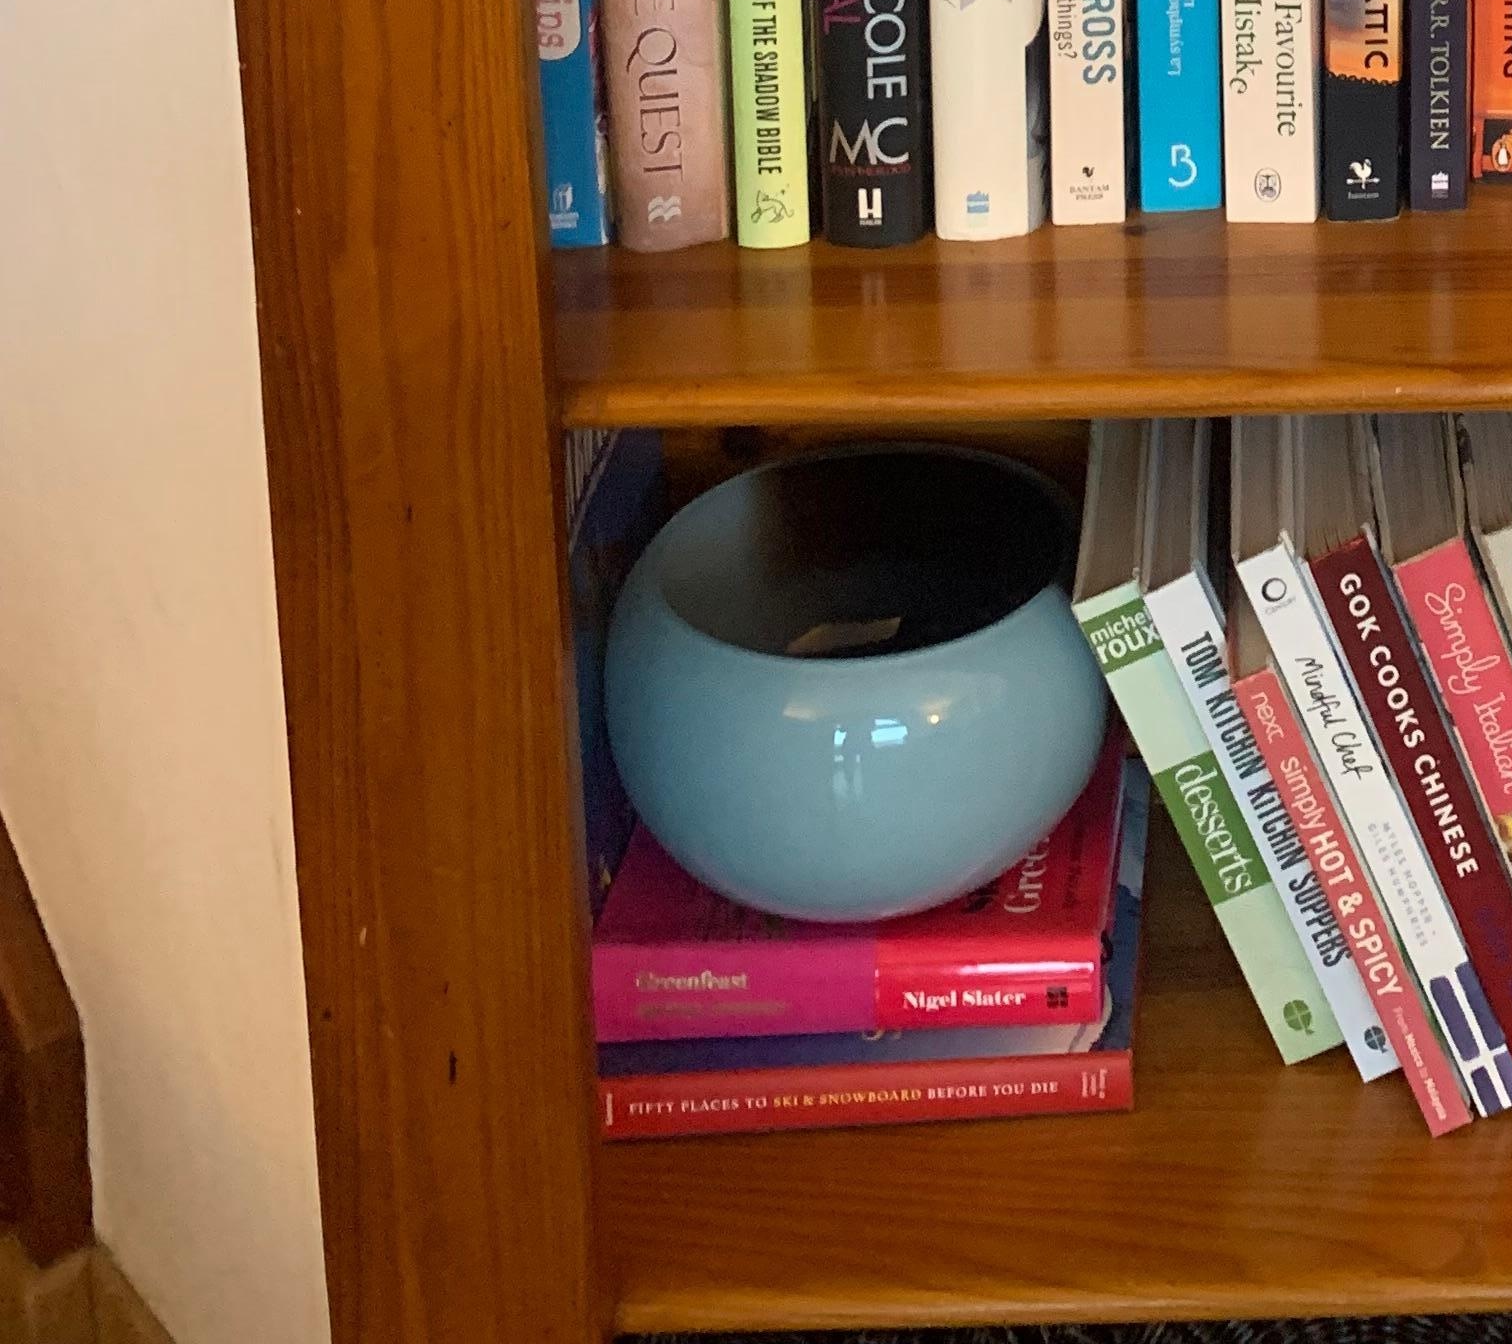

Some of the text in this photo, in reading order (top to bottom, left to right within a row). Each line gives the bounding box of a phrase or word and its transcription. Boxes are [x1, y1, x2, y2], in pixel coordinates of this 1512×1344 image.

[752, 15, 777, 47] THE
[753, 50, 780, 121] SHADOW
[756, 127, 782, 175] BIBLE
[1340, 572, 1479, 878] GOK COOKS CHINESE
[1173, 762, 1257, 894] desserts
[903, 988, 1026, 1009] Nigel Slater
[681, 1099, 739, 1113] PLACES
[745, 1098, 768, 1110] TO
[773, 1095, 799, 1109] SKI
[803, 1095, 815, 1107] &
[820, 1088, 922, 1106] SNOWBOARD
[928, 1084, 986, 1100] BEFORE
[993, 1083, 1026, 1097] YOU
[1031, 1082, 1058, 1095] DIE
